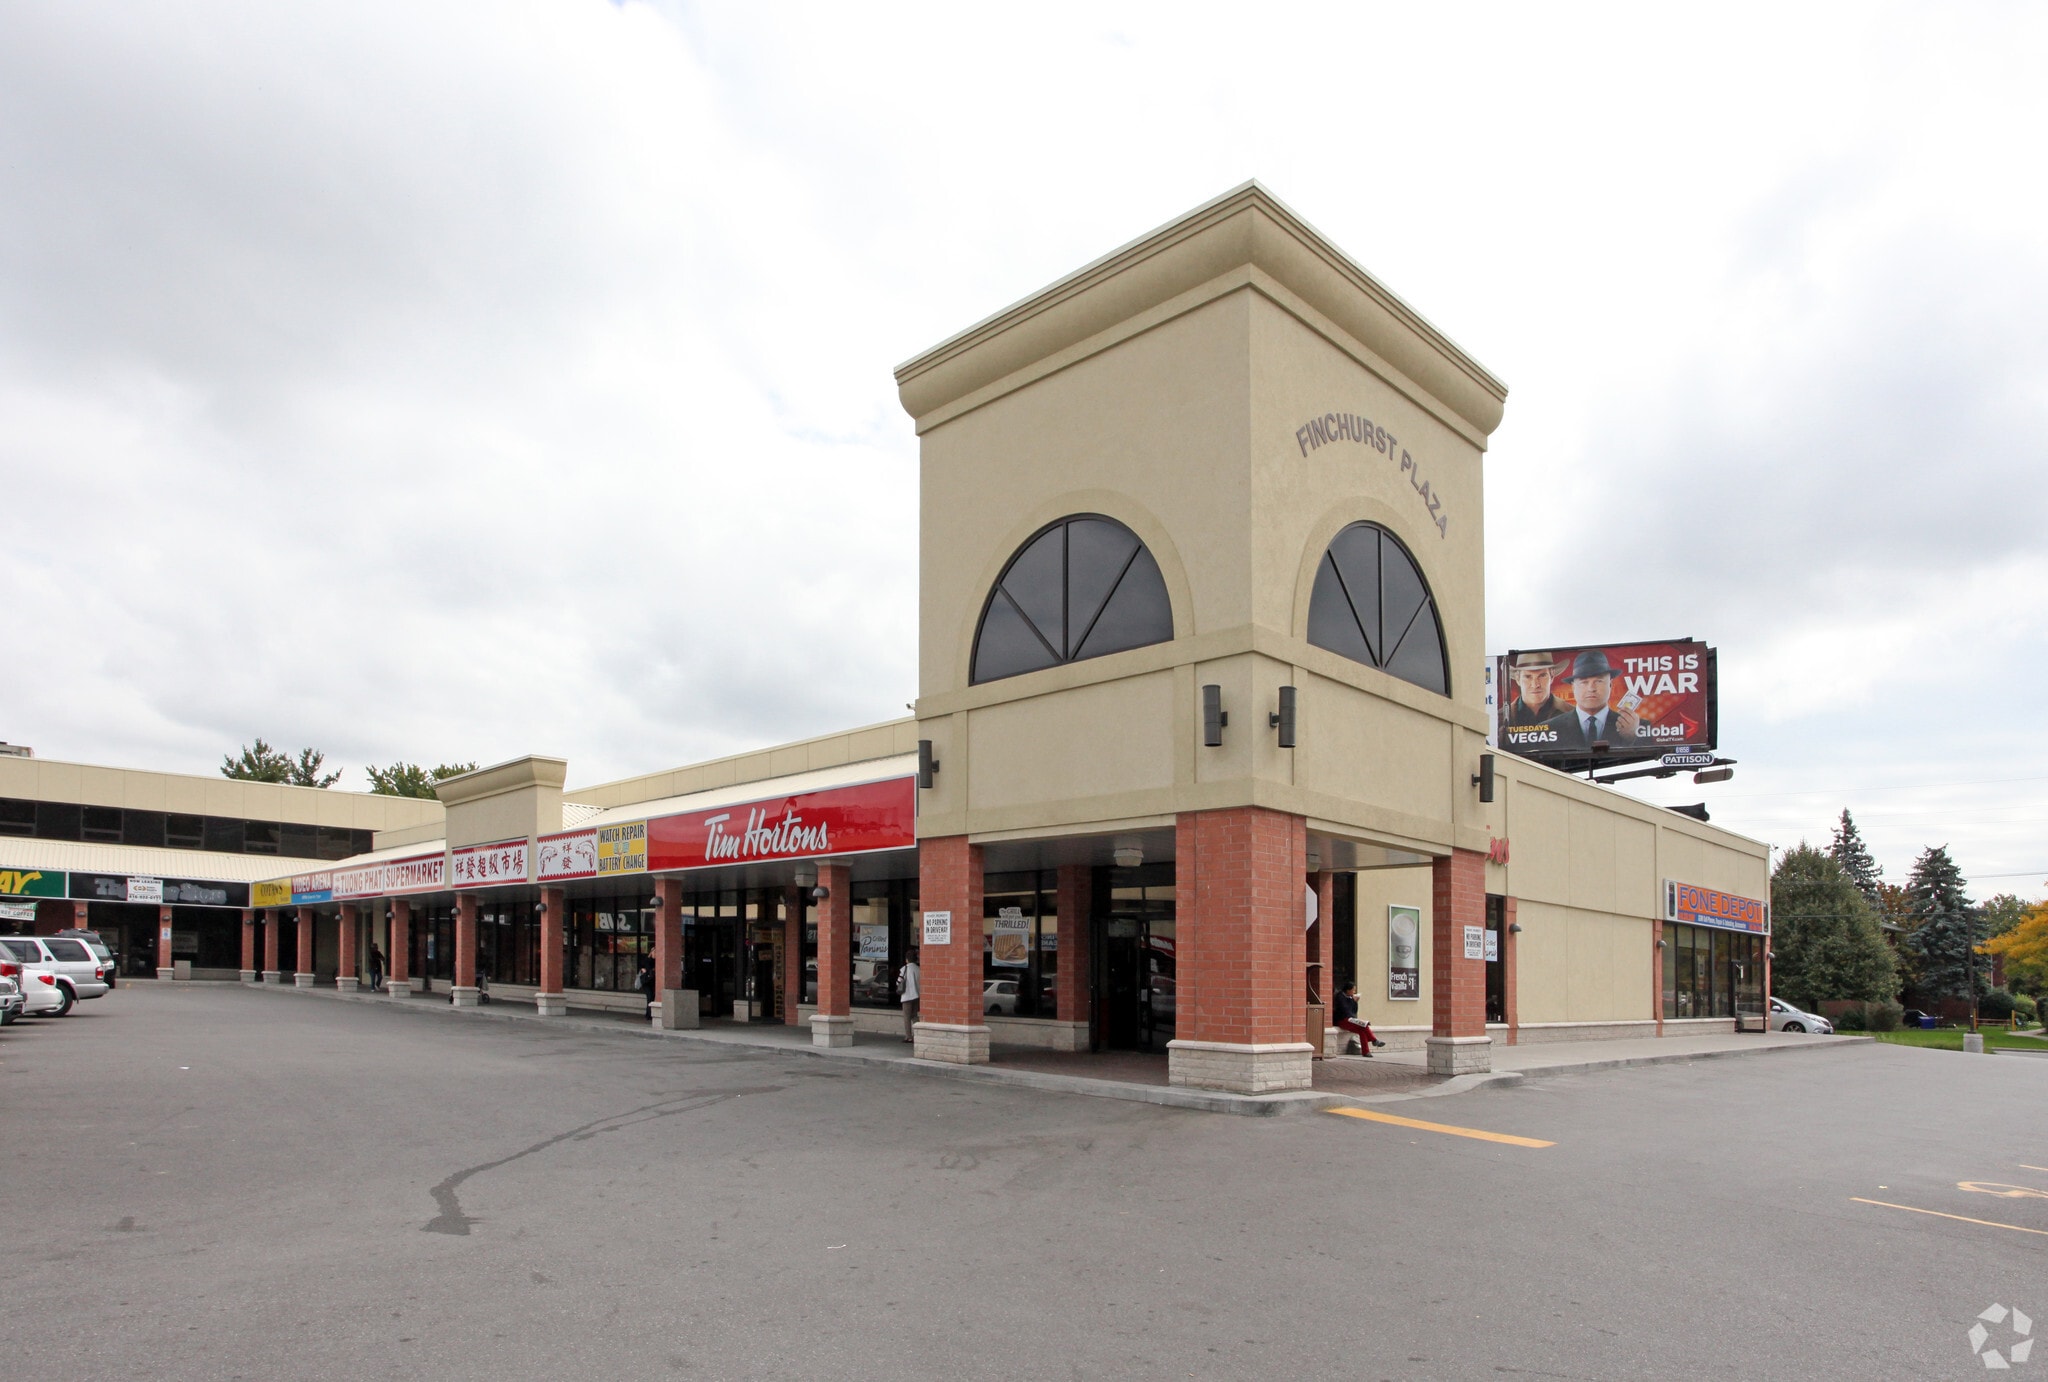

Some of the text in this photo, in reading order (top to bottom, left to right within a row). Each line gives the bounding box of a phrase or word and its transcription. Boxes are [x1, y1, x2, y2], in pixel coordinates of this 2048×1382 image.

[1296, 413, 1447, 540] FINCHURST PLAZA
[1623, 653, 1699, 674] THIS IS
[1623, 672, 1699, 696] WAR
[1507, 724, 1549, 733] TUESDAYS
[1507, 731, 1558, 744] VEGAS
[1635, 723, 1684, 738] Global
[1665, 755, 1711, 764] PATTISON
[600, 824, 645, 843] WATCH REPAIR
[704, 807, 828, 862] Tim Hortons
[599, 853, 645, 872] BATTERY CHANGE
[292, 874, 311, 893] VIDEO
[341, 871, 363, 893] TUONG
[365, 869, 382, 890] PHAT
[386, 860, 444, 888] SUPERMARKET
[1680, 886, 1761, 920] FONE DEPOT
[926, 918, 948, 926] NO PARKING
[926, 926, 948, 934] IN DRIVEWAY
[995, 918, 1030, 929] THRILLED!
[860, 935, 888, 954] Paninis
[1391, 972, 1407, 981] French
[1391, 981, 1407, 990] Vanilla
